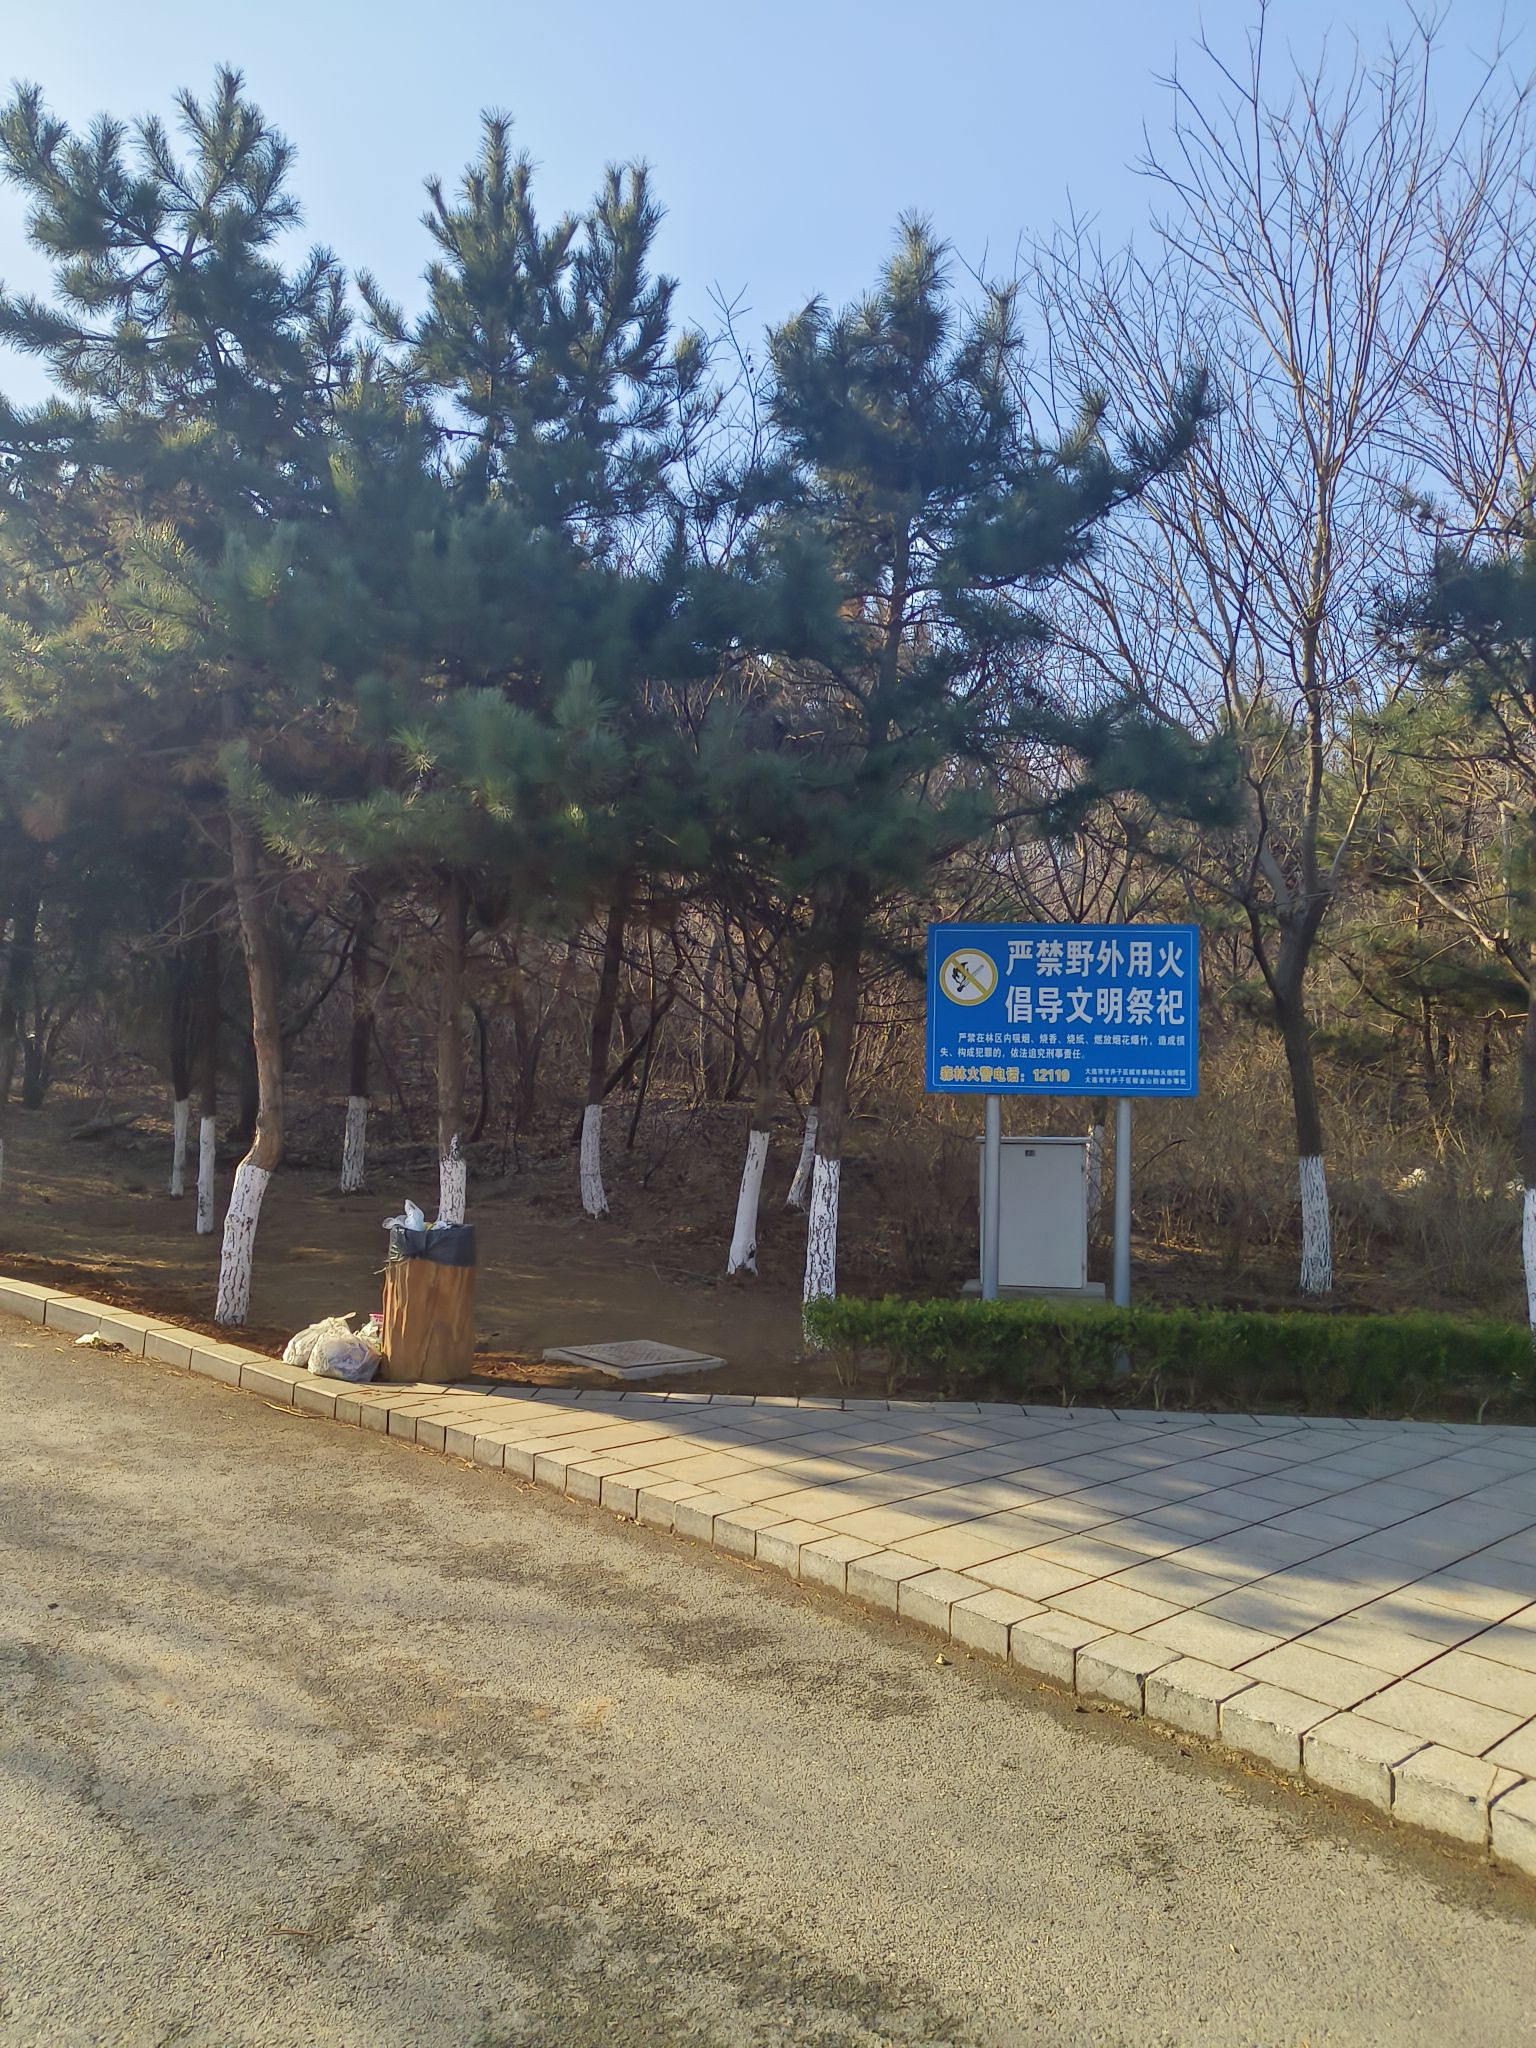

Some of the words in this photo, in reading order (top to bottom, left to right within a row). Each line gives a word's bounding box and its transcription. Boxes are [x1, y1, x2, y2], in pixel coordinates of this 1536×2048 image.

[1005, 940, 1185, 978] 严禁野外用火
[1005, 986, 1185, 1026] 倡导文明祭祀
